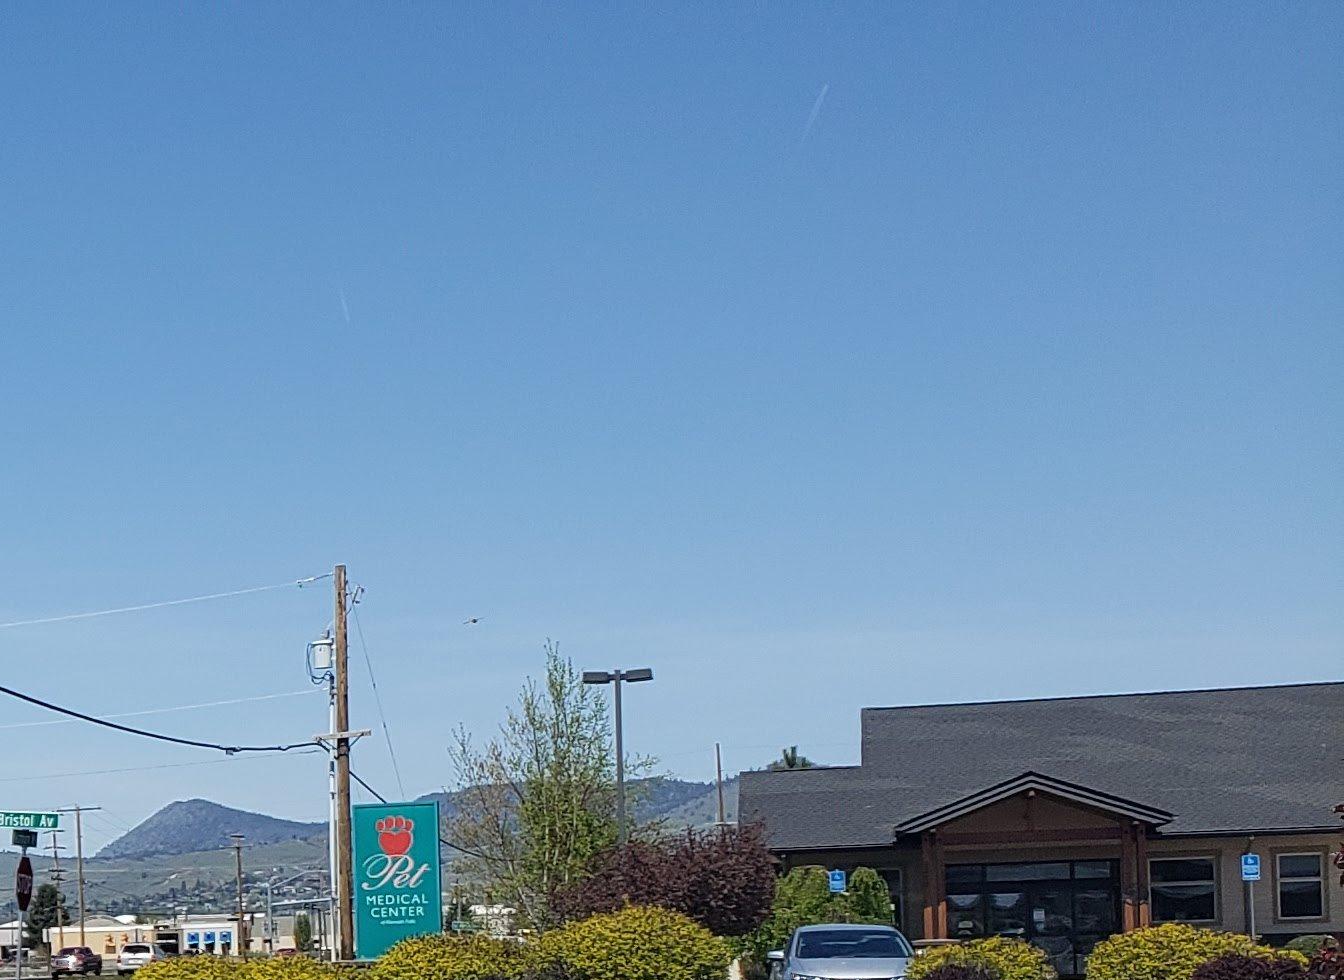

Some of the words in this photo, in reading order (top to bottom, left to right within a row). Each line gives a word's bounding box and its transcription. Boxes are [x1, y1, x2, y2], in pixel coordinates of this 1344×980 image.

[39, 816, 54, 827] Av
[361, 853, 432, 891] Pet
[366, 893, 429, 906] MEDICAL
[370, 905, 424, 918] CENTER
